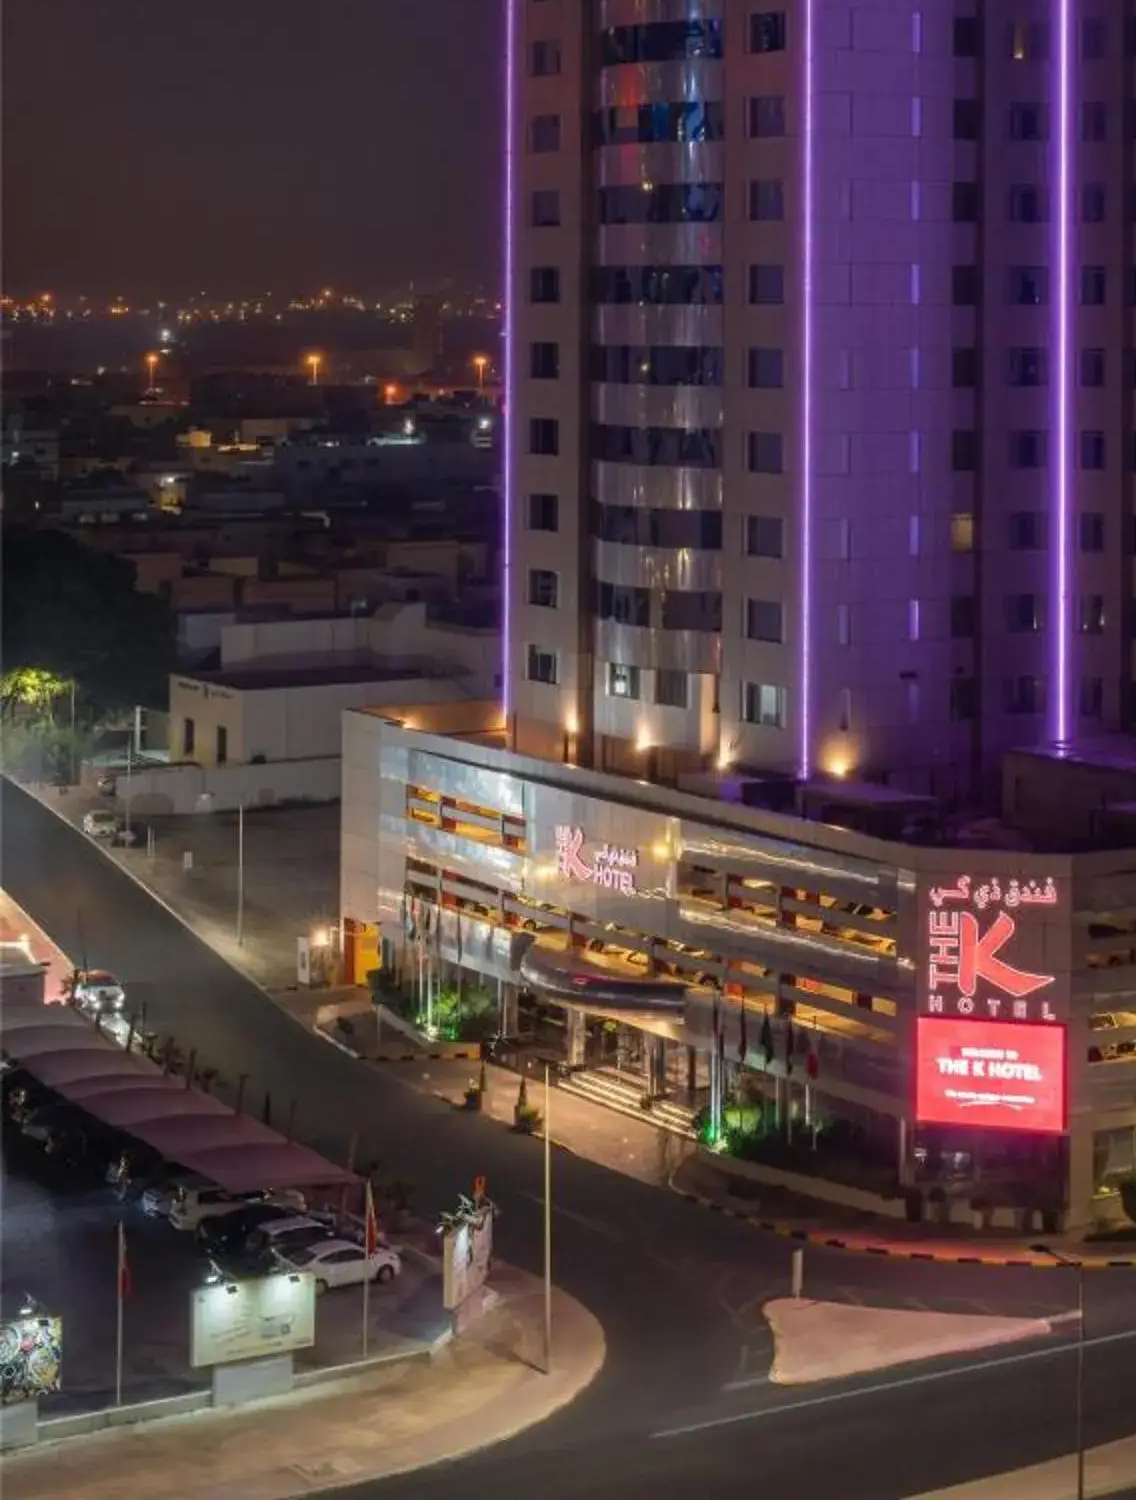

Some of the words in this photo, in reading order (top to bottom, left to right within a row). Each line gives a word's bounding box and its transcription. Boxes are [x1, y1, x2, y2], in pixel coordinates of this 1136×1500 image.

[562, 826, 593, 880] K
[593, 863, 636, 892] HOTEL
[1004, 876, 1057, 907] فندق
[929, 911, 959, 990] THE
[957, 910, 1056, 997] K
[928, 994, 1057, 1021] HOTEL
[936, 1057, 969, 1076] THE
[971, 1059, 986, 1077] K
[987, 1061, 1043, 1081] HOTEL
